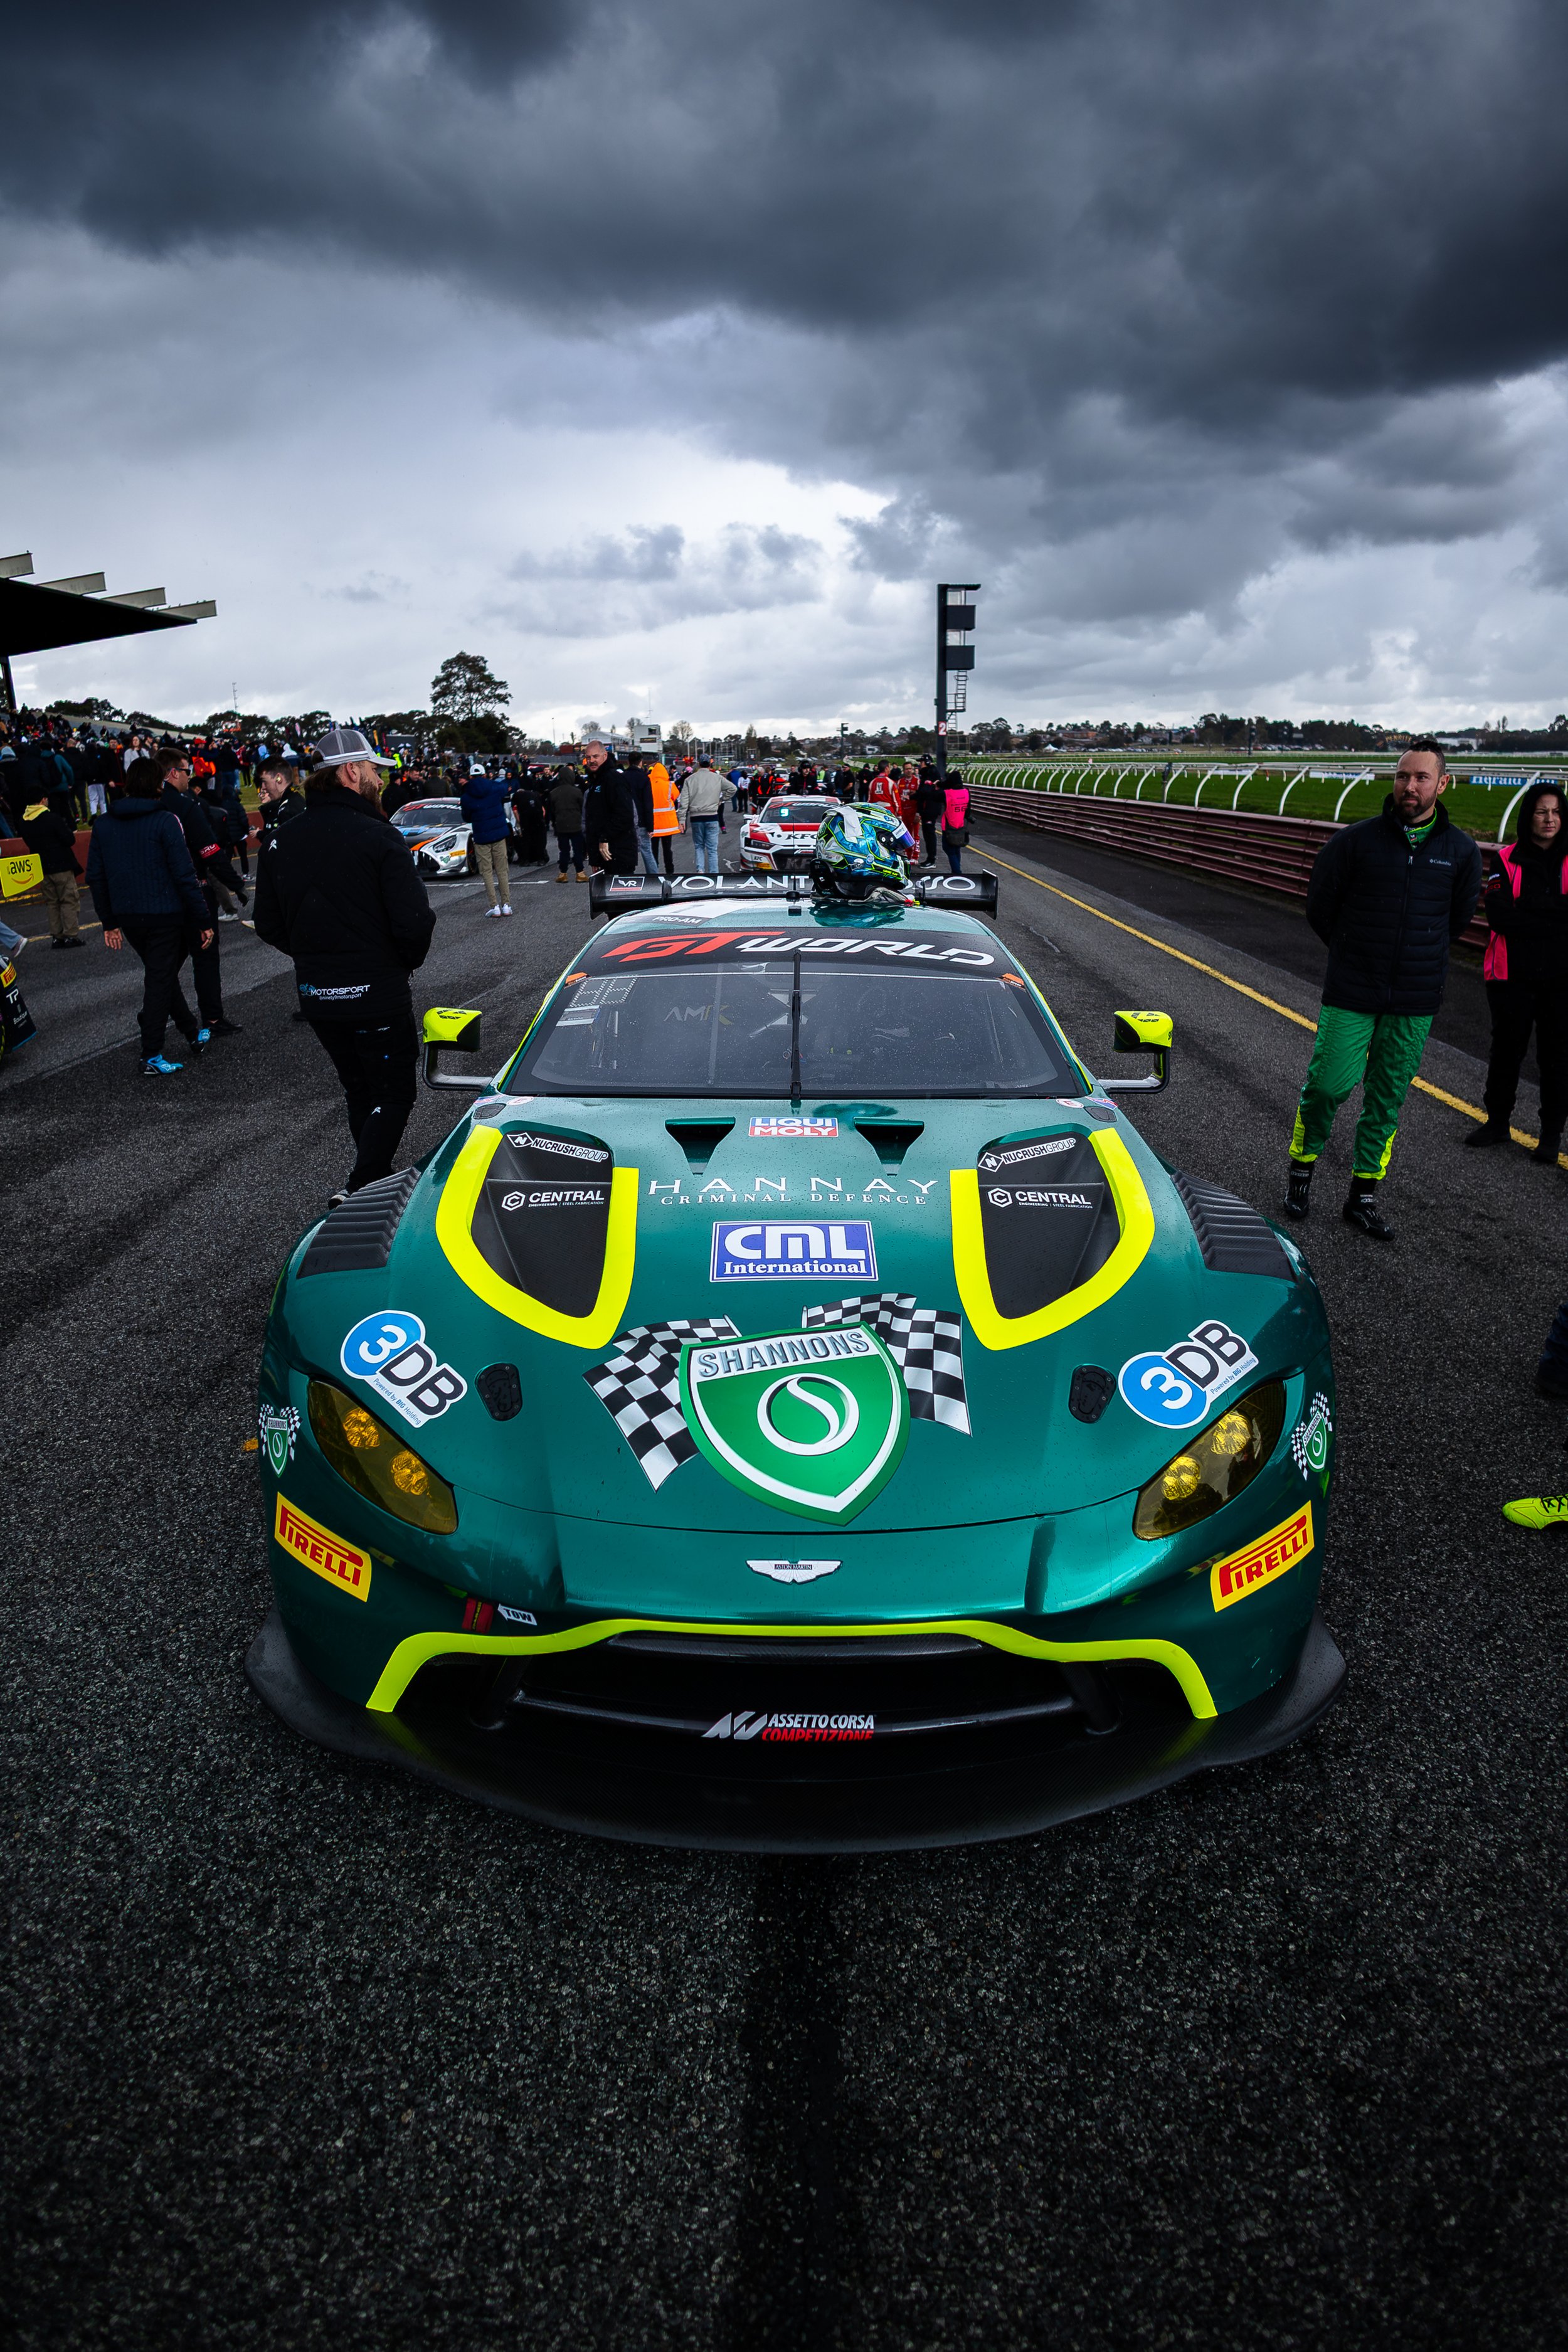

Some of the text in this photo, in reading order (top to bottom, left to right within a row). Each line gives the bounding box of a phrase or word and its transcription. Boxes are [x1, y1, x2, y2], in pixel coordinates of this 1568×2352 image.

[939, 723, 946, 735] 2
[780, 808, 788, 817] 9
[10, 859, 31, 874] aws
[658, 876, 809, 890] VOLANT
[652, 916, 702, 924] PRO-AM
[310, 985, 370, 995] MOTORSPORT
[755, 1118, 832, 1126] LIQUI
[754, 1126, 835, 1135] MOLY
[648, 1177, 938, 1195] HANNAY
[529, 1190, 605, 1202] CENTRAL
[661, 1194, 926, 1205] CRIMINAL DEFENCE
[1015, 1191, 1091, 1205] CENTRAL
[724, 1259, 867, 1274] International
[698, 1332, 869, 1378] SHANNONS
[359, 1325, 464, 1416] 3DB
[1140, 1323, 1247, 1410] 3DB
[1210, 1377, 1230, 1395] Powered
[1232, 1367, 1241, 1376] BIG
[1241, 1357, 1256, 1371] Holding
[373, 1378, 421, 1425] Powered by BIG Holding
[268, 1418, 287, 1429] SHANNONS
[279, 1504, 364, 1587] PIRELLI
[1219, 1514, 1308, 1597] PIRELLI
[503, 1608, 532, 1622] TOW
[768, 1714, 874, 1729] ASSETTO CORSA
[762, 1728, 874, 1742] COMPETIZIONE
